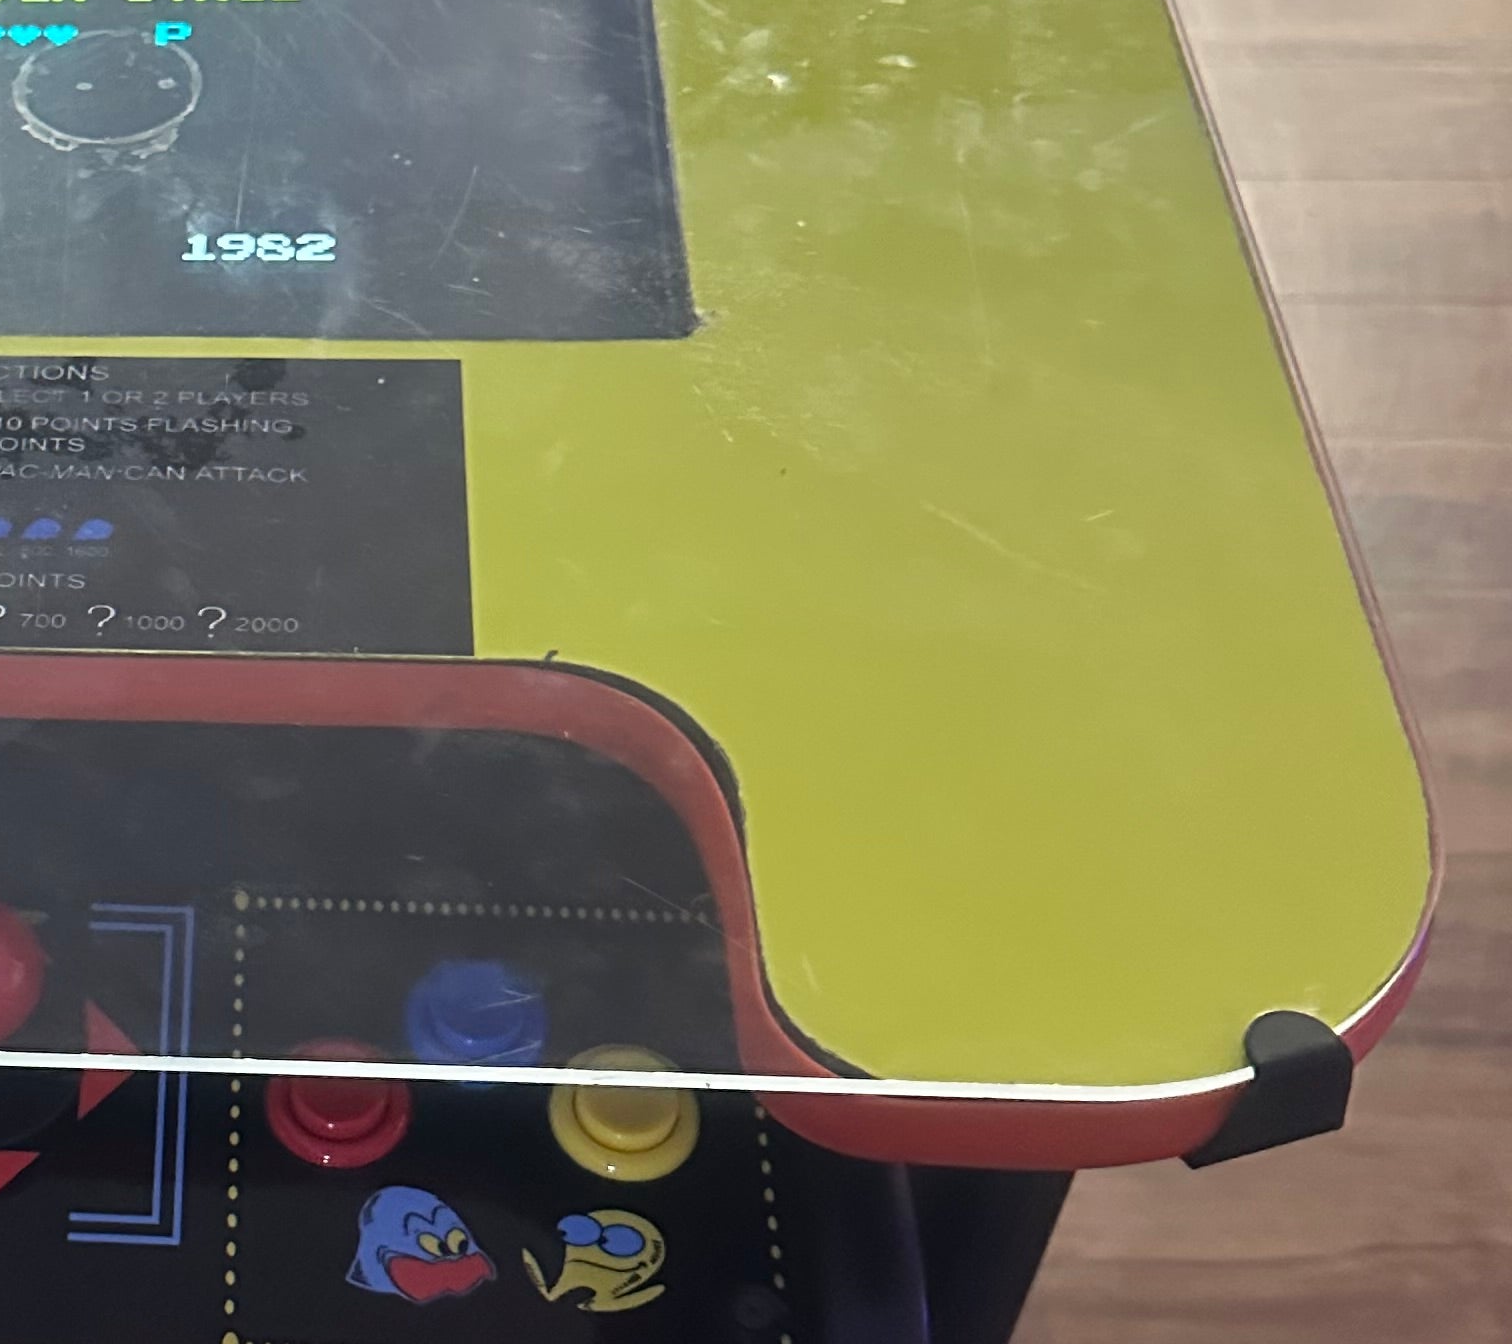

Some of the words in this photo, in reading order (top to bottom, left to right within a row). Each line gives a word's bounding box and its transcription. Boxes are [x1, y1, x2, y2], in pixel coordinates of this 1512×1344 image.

[153, 21, 193, 47] P
[181, 231, 338, 263] 1982
[101, 391, 143, 405] OR
[152, 391, 170, 405] 2
[177, 390, 311, 406] PLAYERS
[30, 416, 139, 433] POINTS
[146, 417, 294, 434] FLASHING
[123, 465, 186, 481] CAN
[194, 466, 311, 483] ATTACK
[19, 612, 67, 629] 700
[124, 614, 186, 632] 1000
[233, 617, 300, 634] 2000
